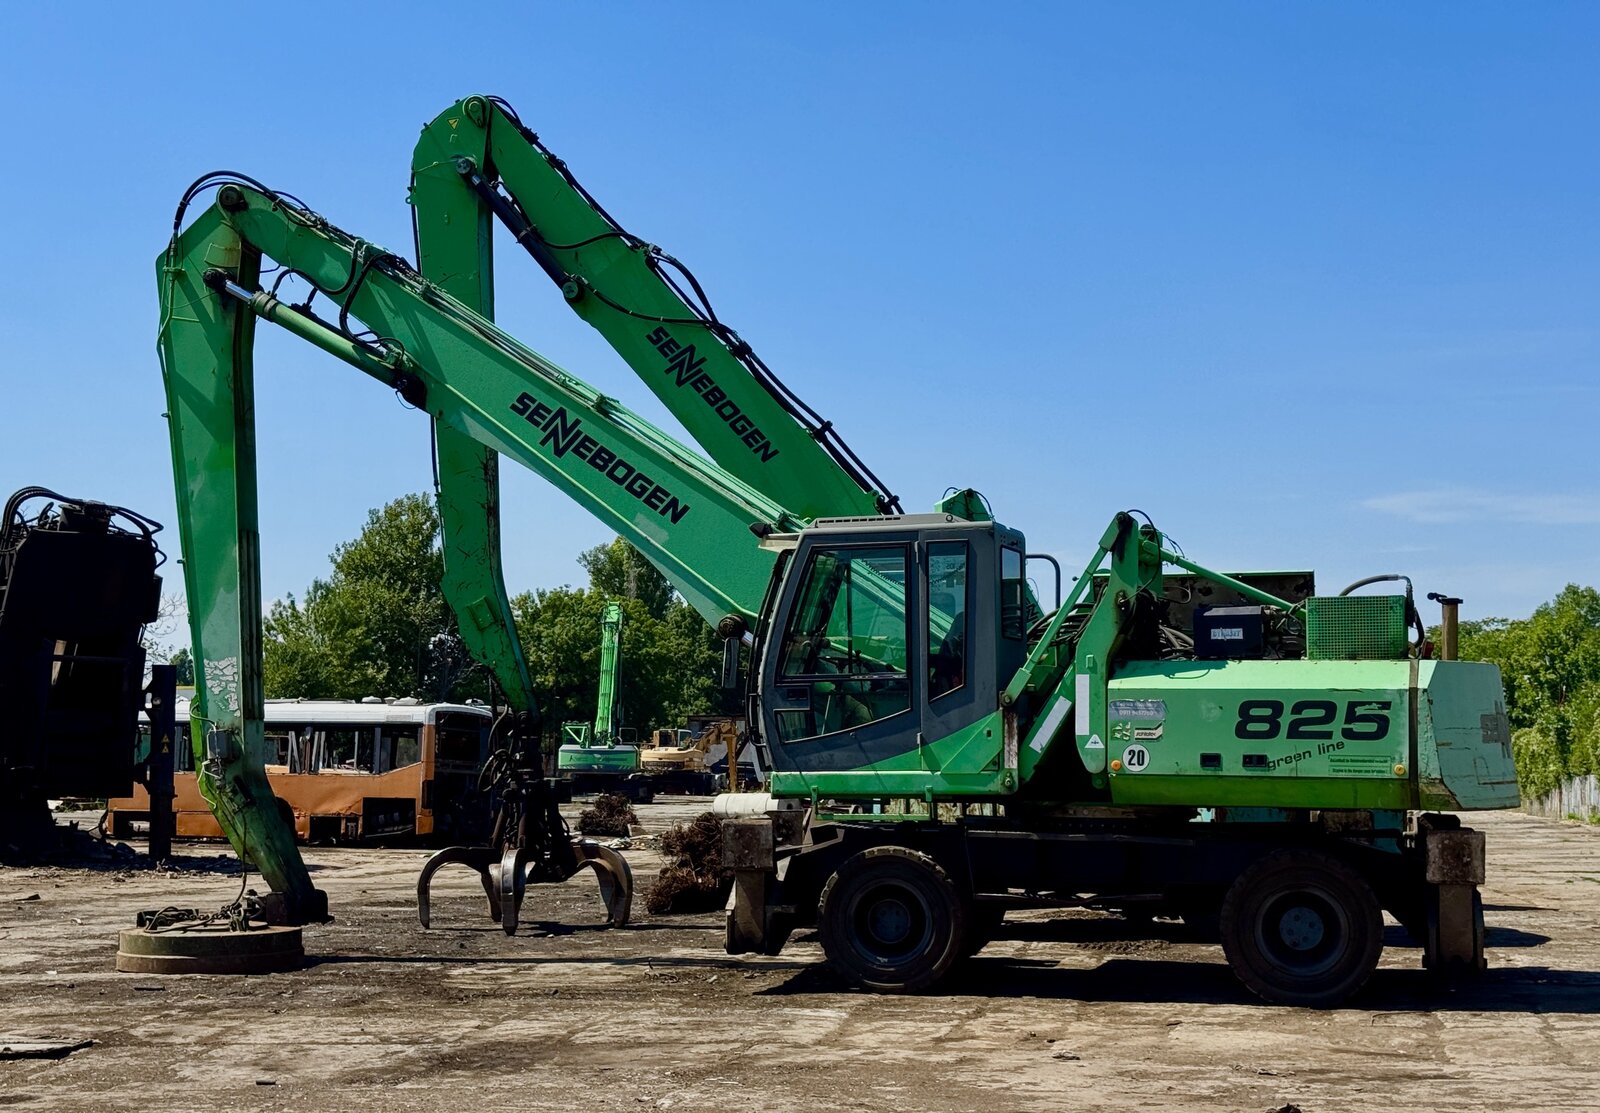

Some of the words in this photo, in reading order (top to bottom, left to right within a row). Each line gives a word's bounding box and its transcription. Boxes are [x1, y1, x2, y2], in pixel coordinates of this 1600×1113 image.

[645, 326, 780, 463] SENNEBOGEN
[509, 391, 691, 525] SENNEBOGEN
[1234, 699, 1393, 741] 825
[1127, 749, 1145, 766] 20
[1267, 750, 1312, 771] green
[1317, 740, 1345, 755] line
